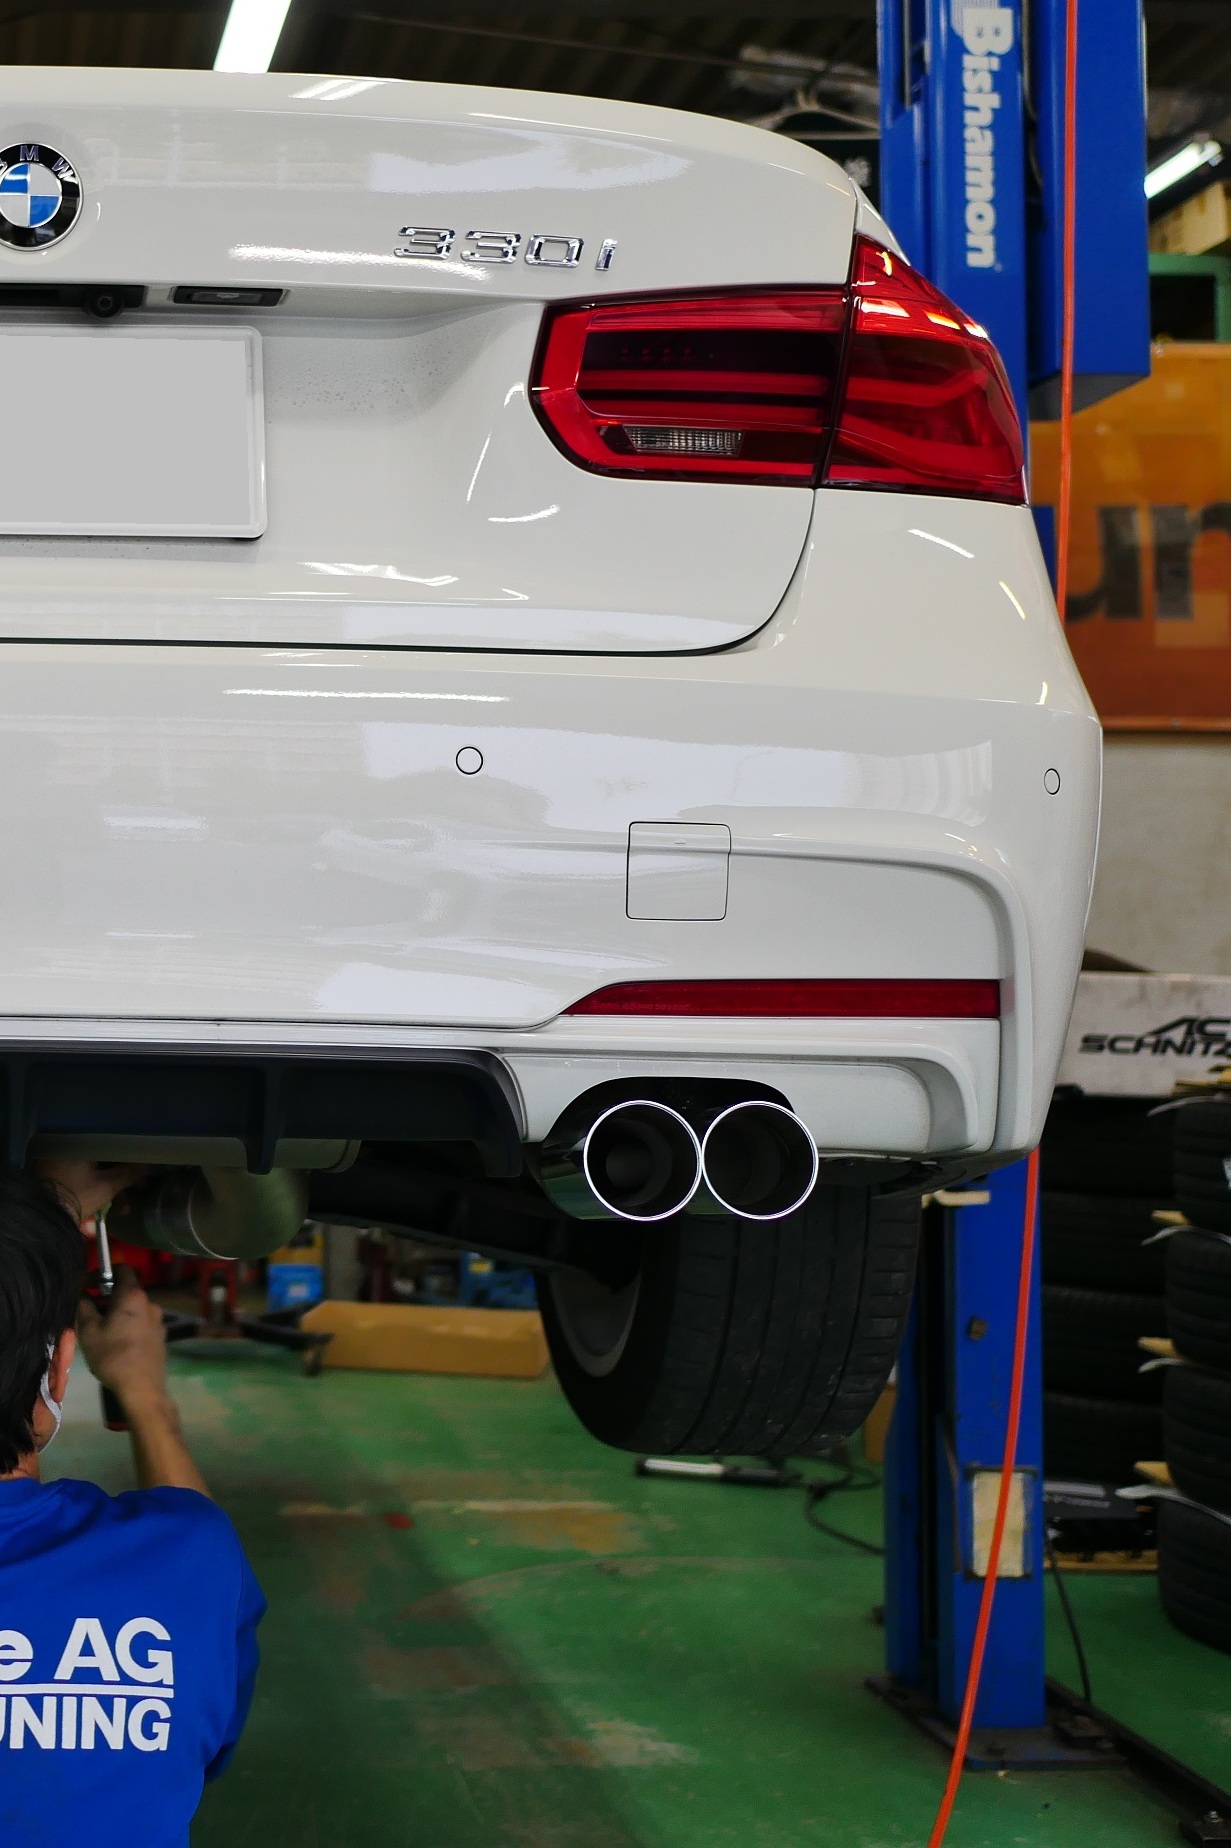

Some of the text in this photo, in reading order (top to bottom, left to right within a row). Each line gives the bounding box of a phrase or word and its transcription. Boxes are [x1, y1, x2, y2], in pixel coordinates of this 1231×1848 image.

[962, 7, 1014, 269] Bishamon
[394, 226, 617, 271] 330i
[54, 1617, 174, 1685] AG
